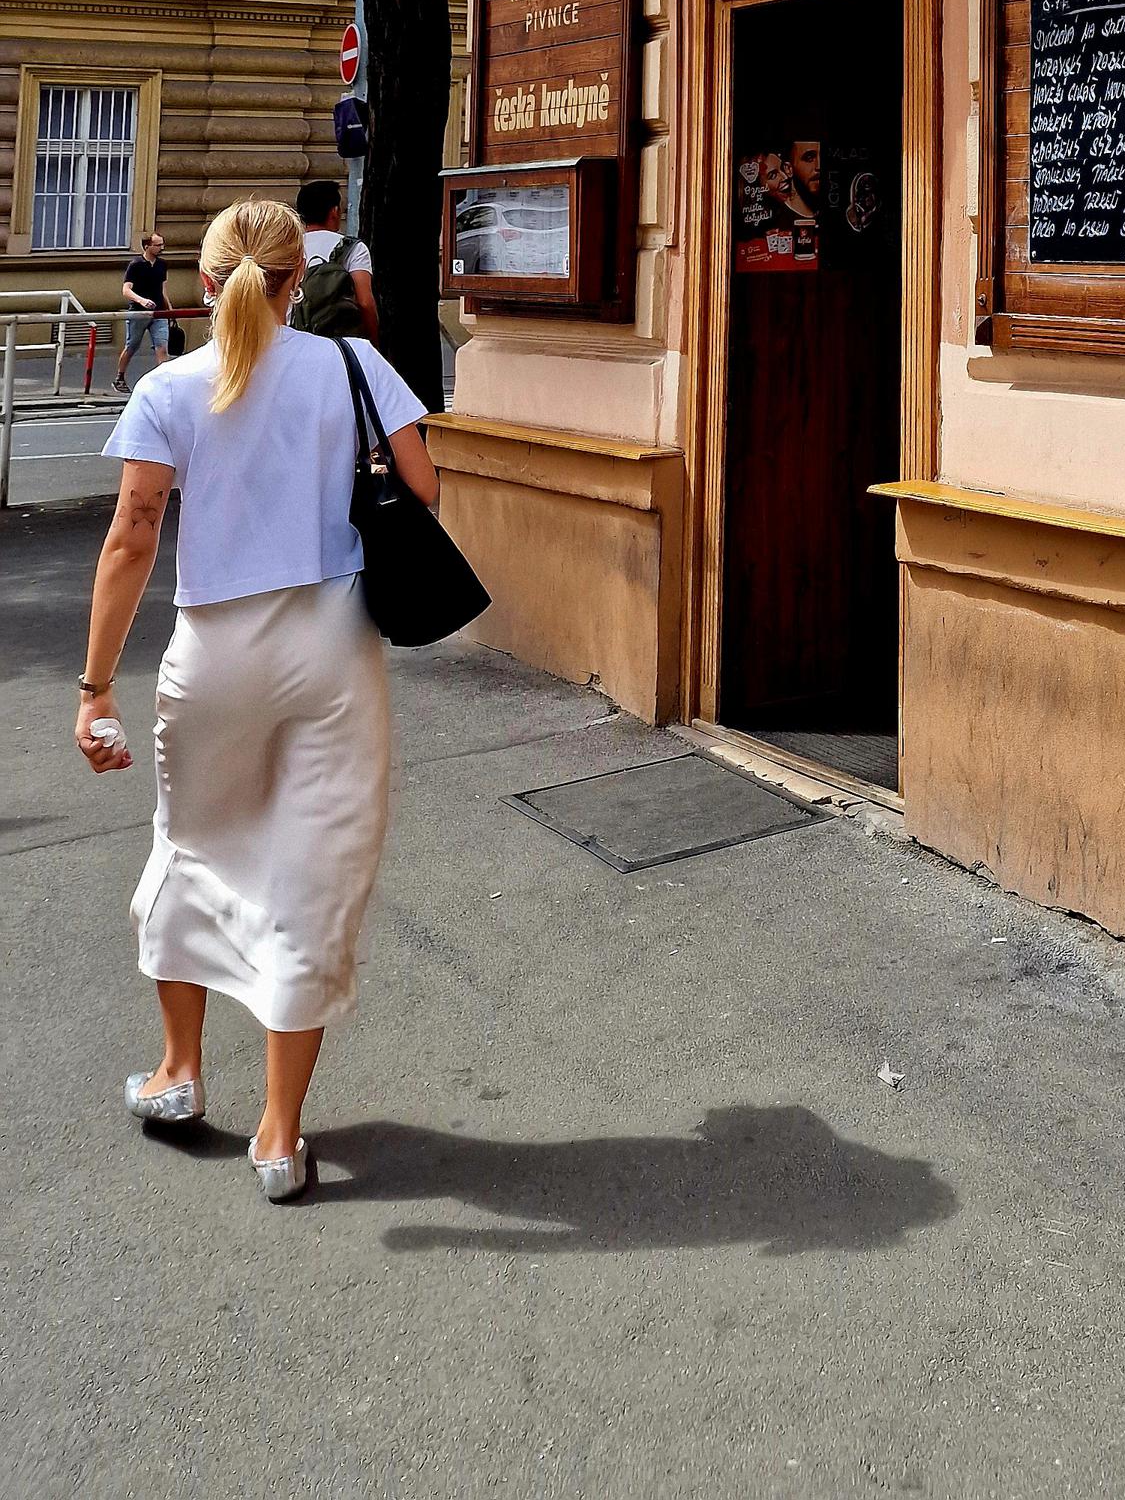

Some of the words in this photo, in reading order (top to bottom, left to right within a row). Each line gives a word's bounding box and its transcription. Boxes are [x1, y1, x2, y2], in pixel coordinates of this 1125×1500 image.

[525, 1, 580, 33] PIVNICE
[493, 84, 534, 132] česká
[540, 72, 610, 129] kuchyně
